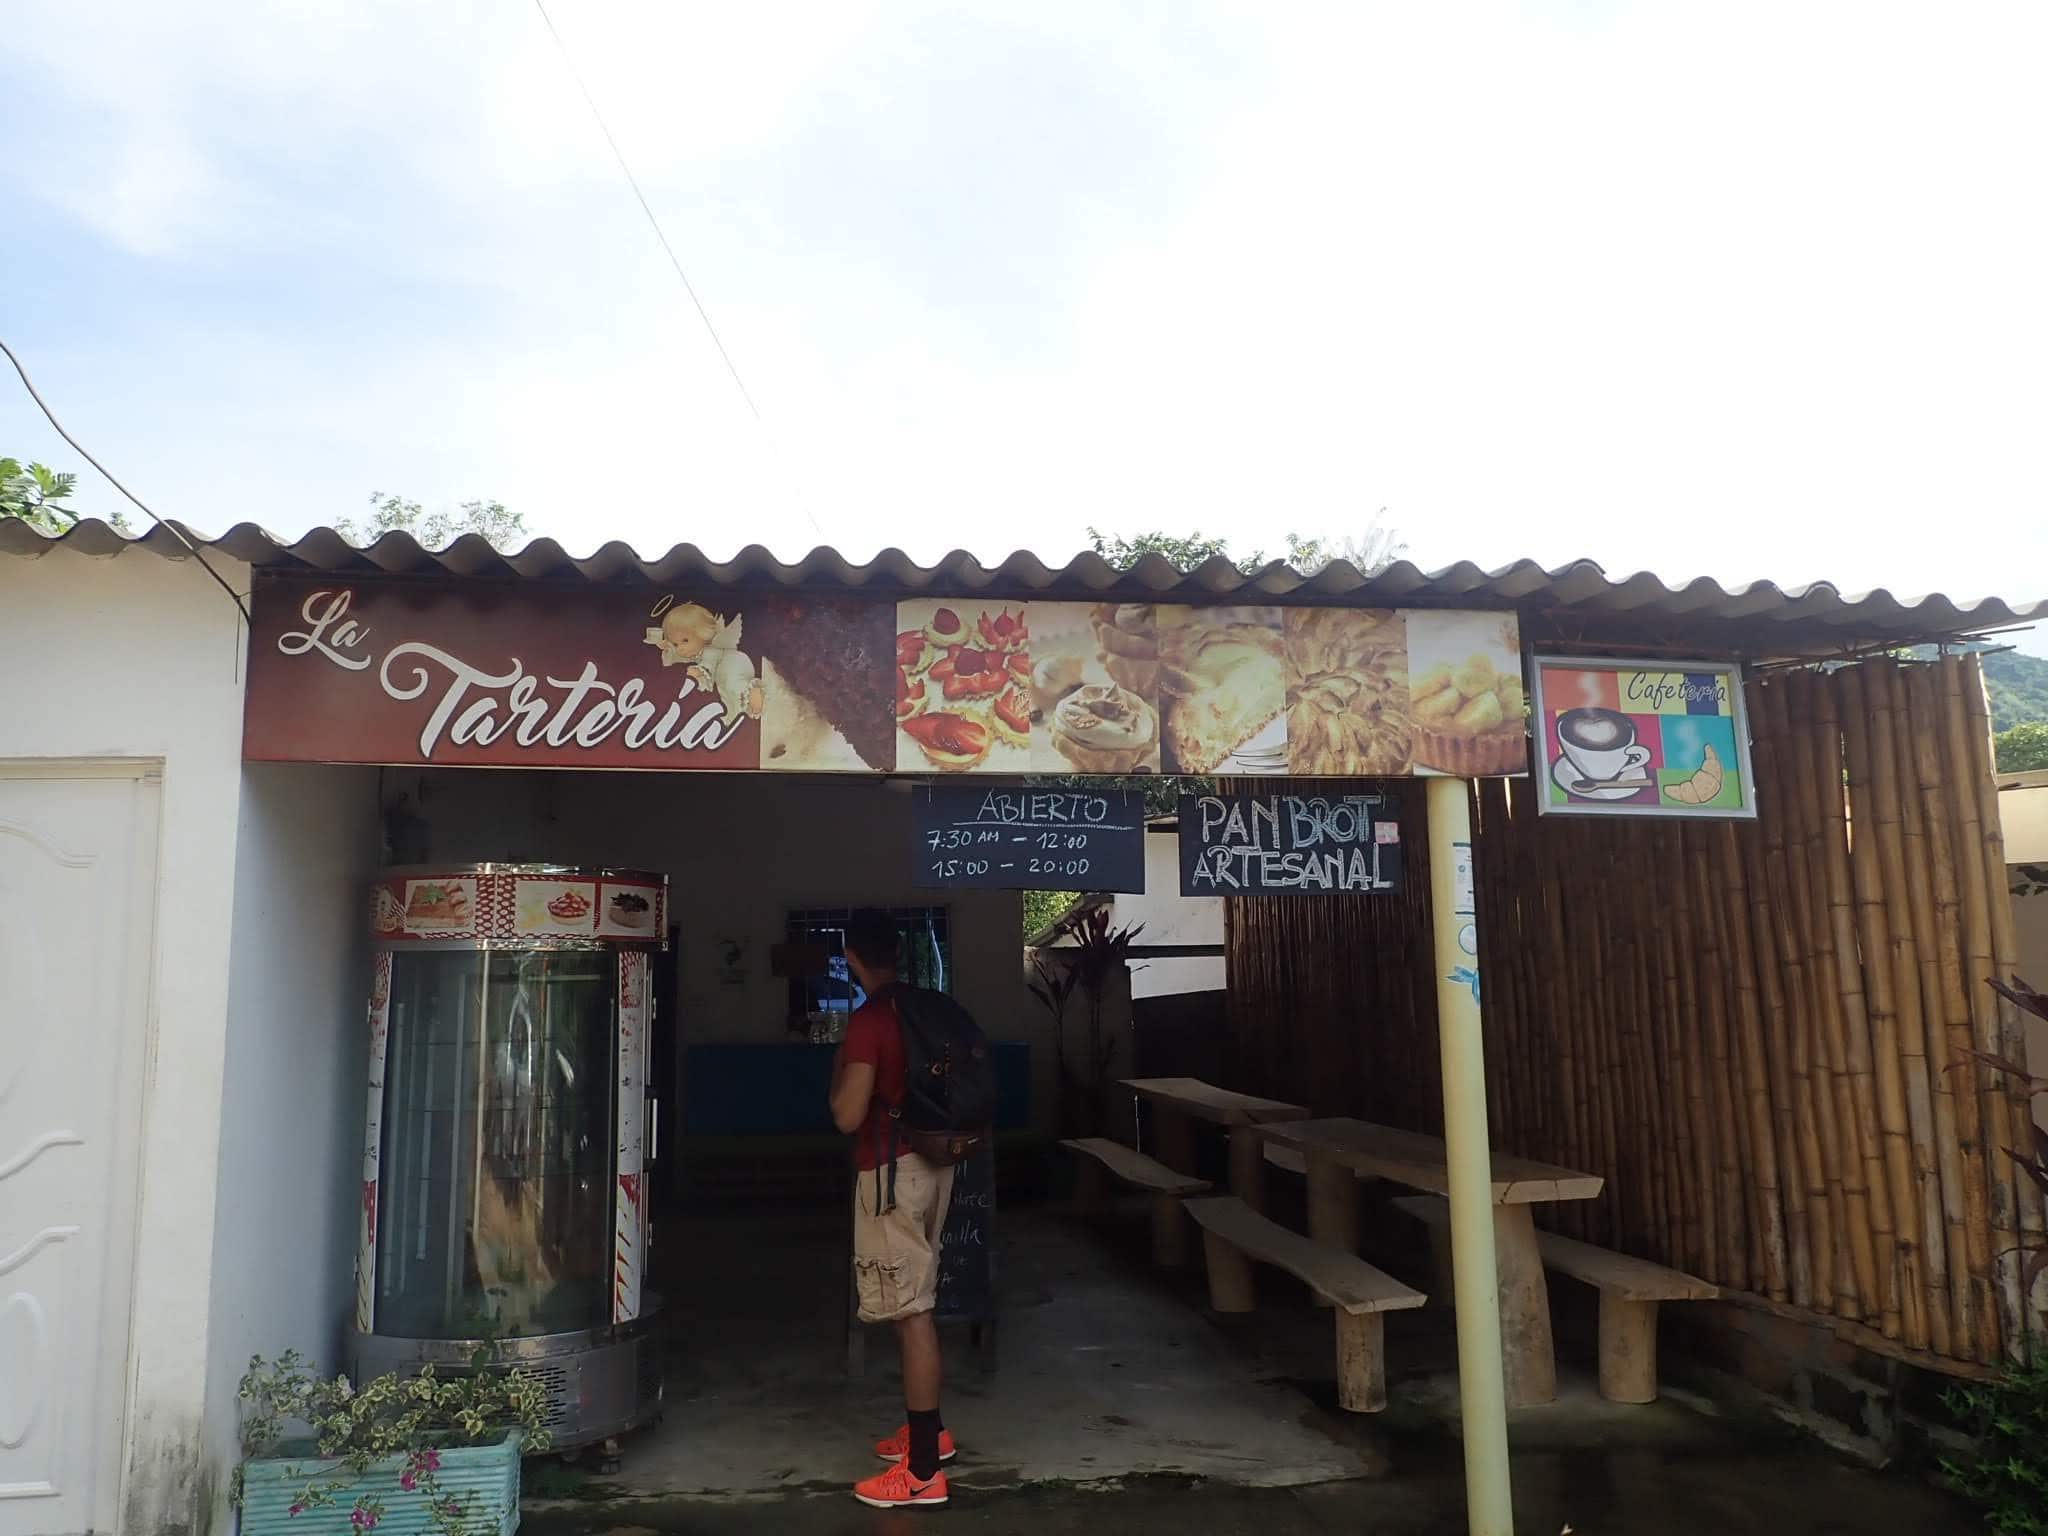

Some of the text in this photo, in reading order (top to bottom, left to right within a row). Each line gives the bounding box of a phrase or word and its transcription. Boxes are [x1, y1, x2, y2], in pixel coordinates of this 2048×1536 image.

[278, 590, 743, 758] La Tartería
[1627, 671, 1727, 710] Cafeteria
[977, 788, 1108, 822] ABIERTO
[1198, 795, 1381, 849] PAN BROT
[927, 830, 972, 852] 7:30
[977, 831, 1000, 843] AM
[1036, 832, 1087, 849] 12:00
[932, 859, 989, 878] 15:00
[1029, 858, 1090, 875] 20:00
[1192, 842, 1394, 890] ARTESANAL
